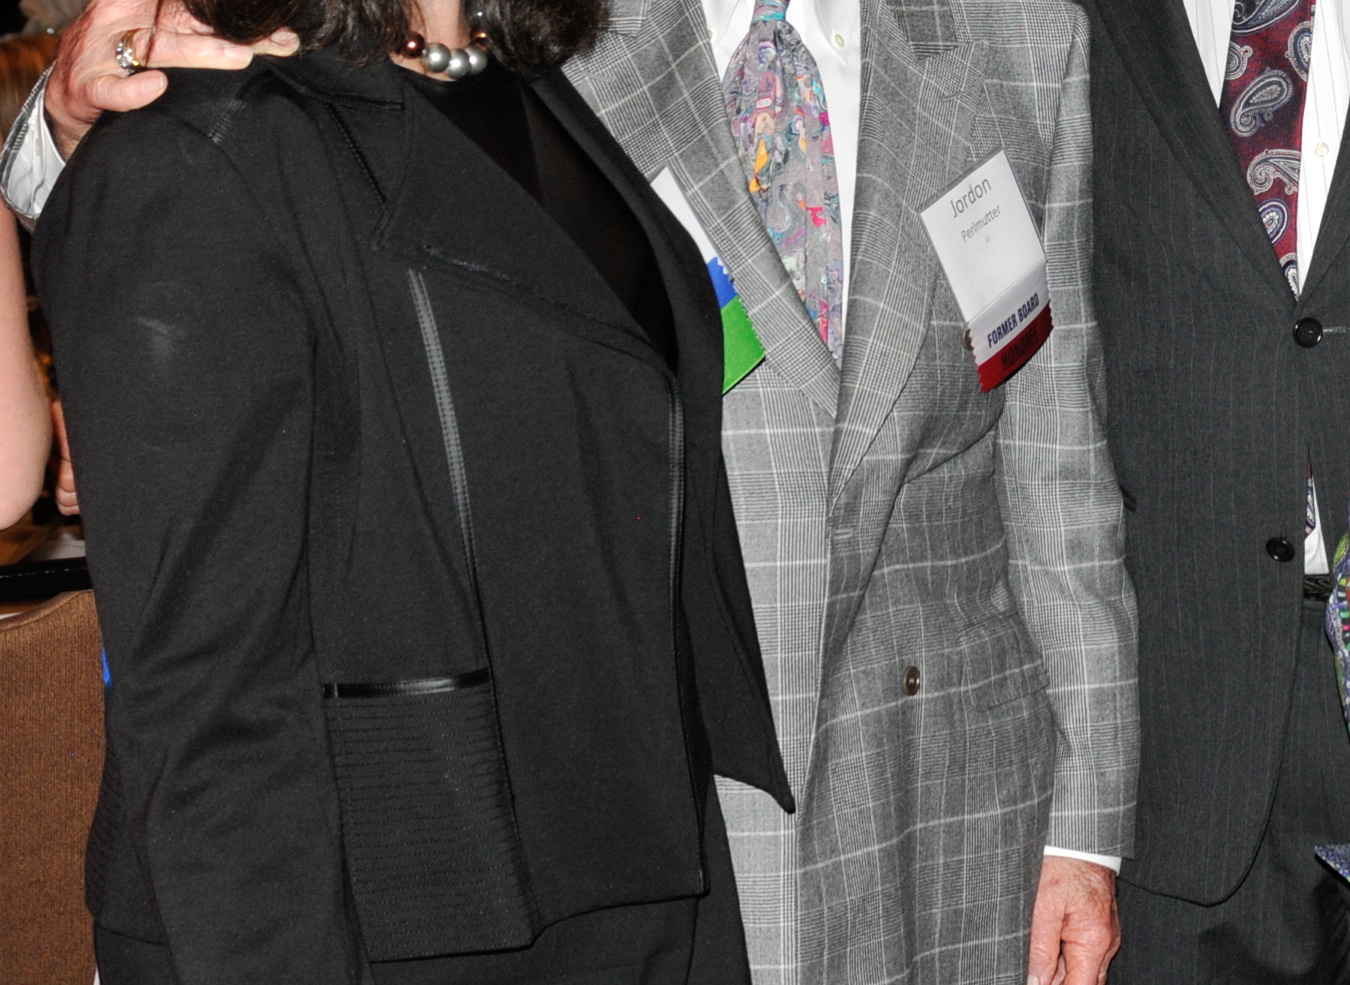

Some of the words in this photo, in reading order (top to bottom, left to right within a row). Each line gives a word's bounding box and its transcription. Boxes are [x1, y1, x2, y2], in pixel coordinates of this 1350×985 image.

[950, 179, 992, 218] Jordon
[960, 205, 1001, 242] Perlmutter
[987, 313, 1018, 348] FORMER
[1017, 292, 1040, 323] BOARD
